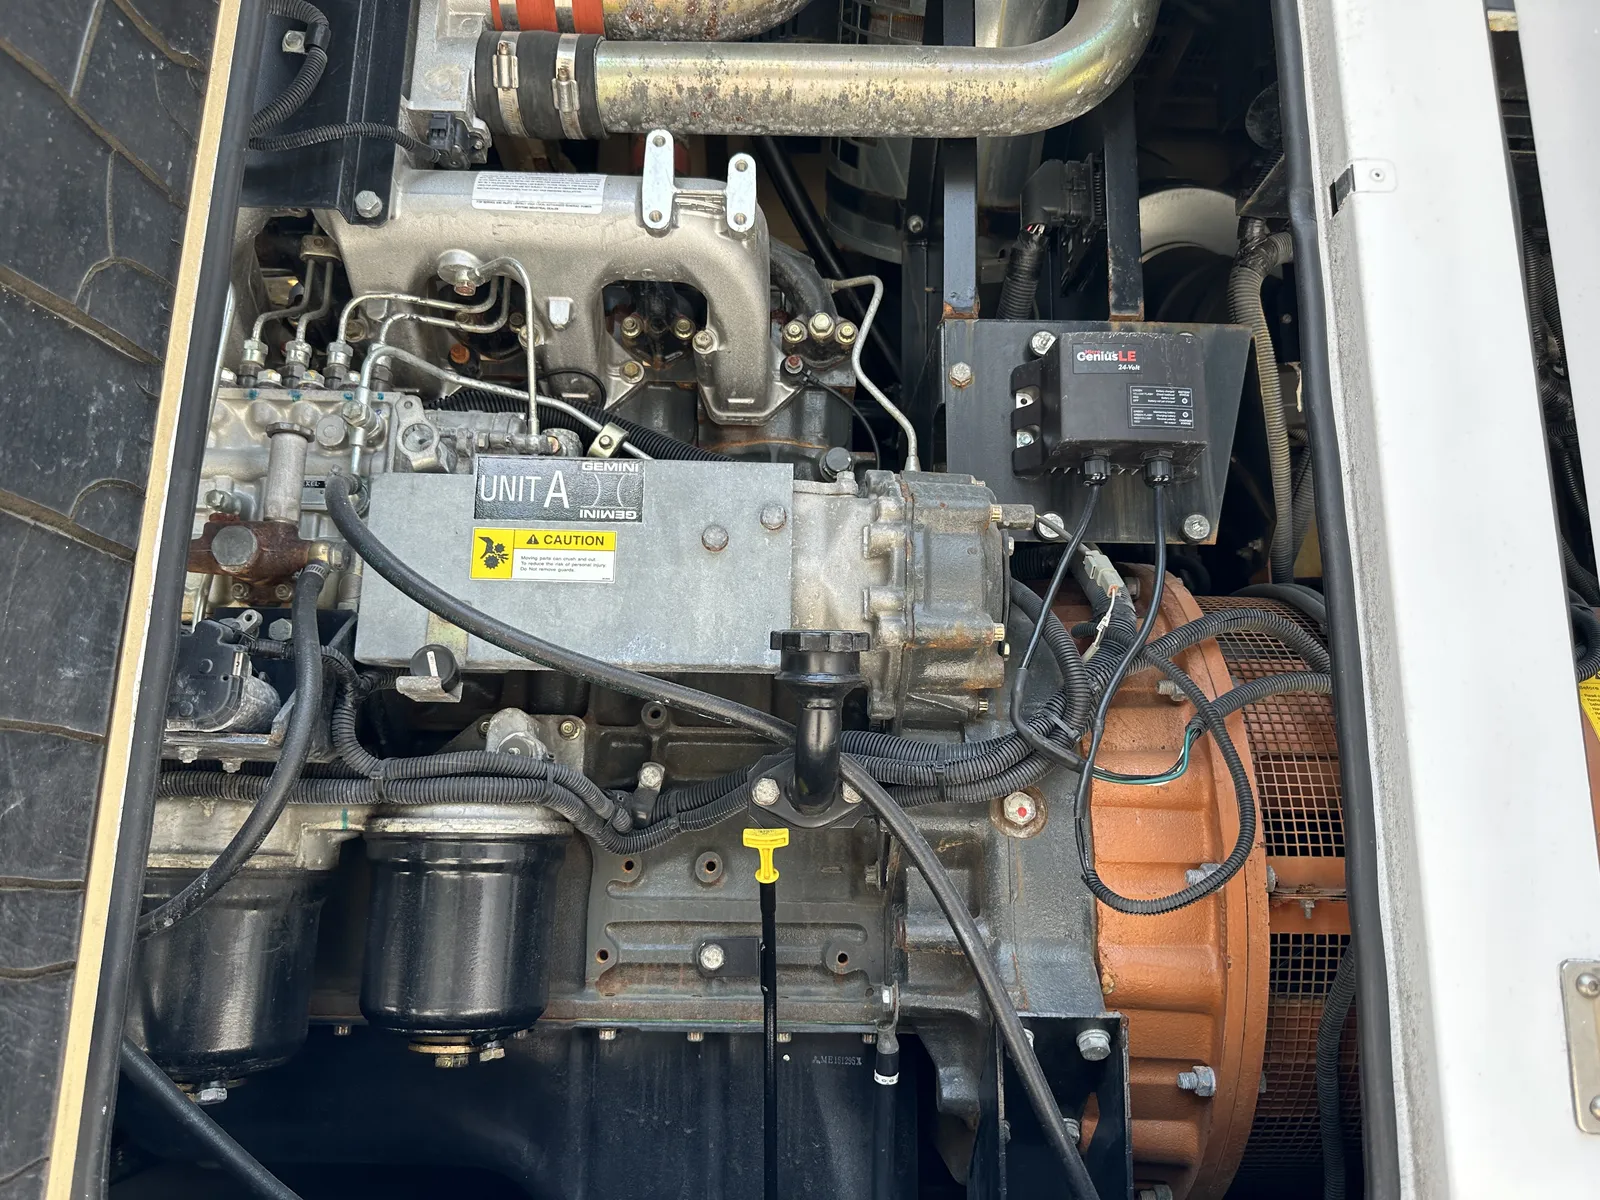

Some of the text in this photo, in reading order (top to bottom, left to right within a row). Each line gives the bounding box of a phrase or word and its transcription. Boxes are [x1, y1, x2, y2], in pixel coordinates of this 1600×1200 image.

[582, 462, 639, 472] GEMINI
[480, 470, 570, 508] UNIT A
[580, 510, 637, 520] GEMINI
[544, 534, 604, 546] CAUTION
[387, 570, 404, 590] FUEL
[408, 588, 448, 617] INJECTION
[451, 616, 476, 632] HOSE
[153, 1078, 177, 1100] HOSE
